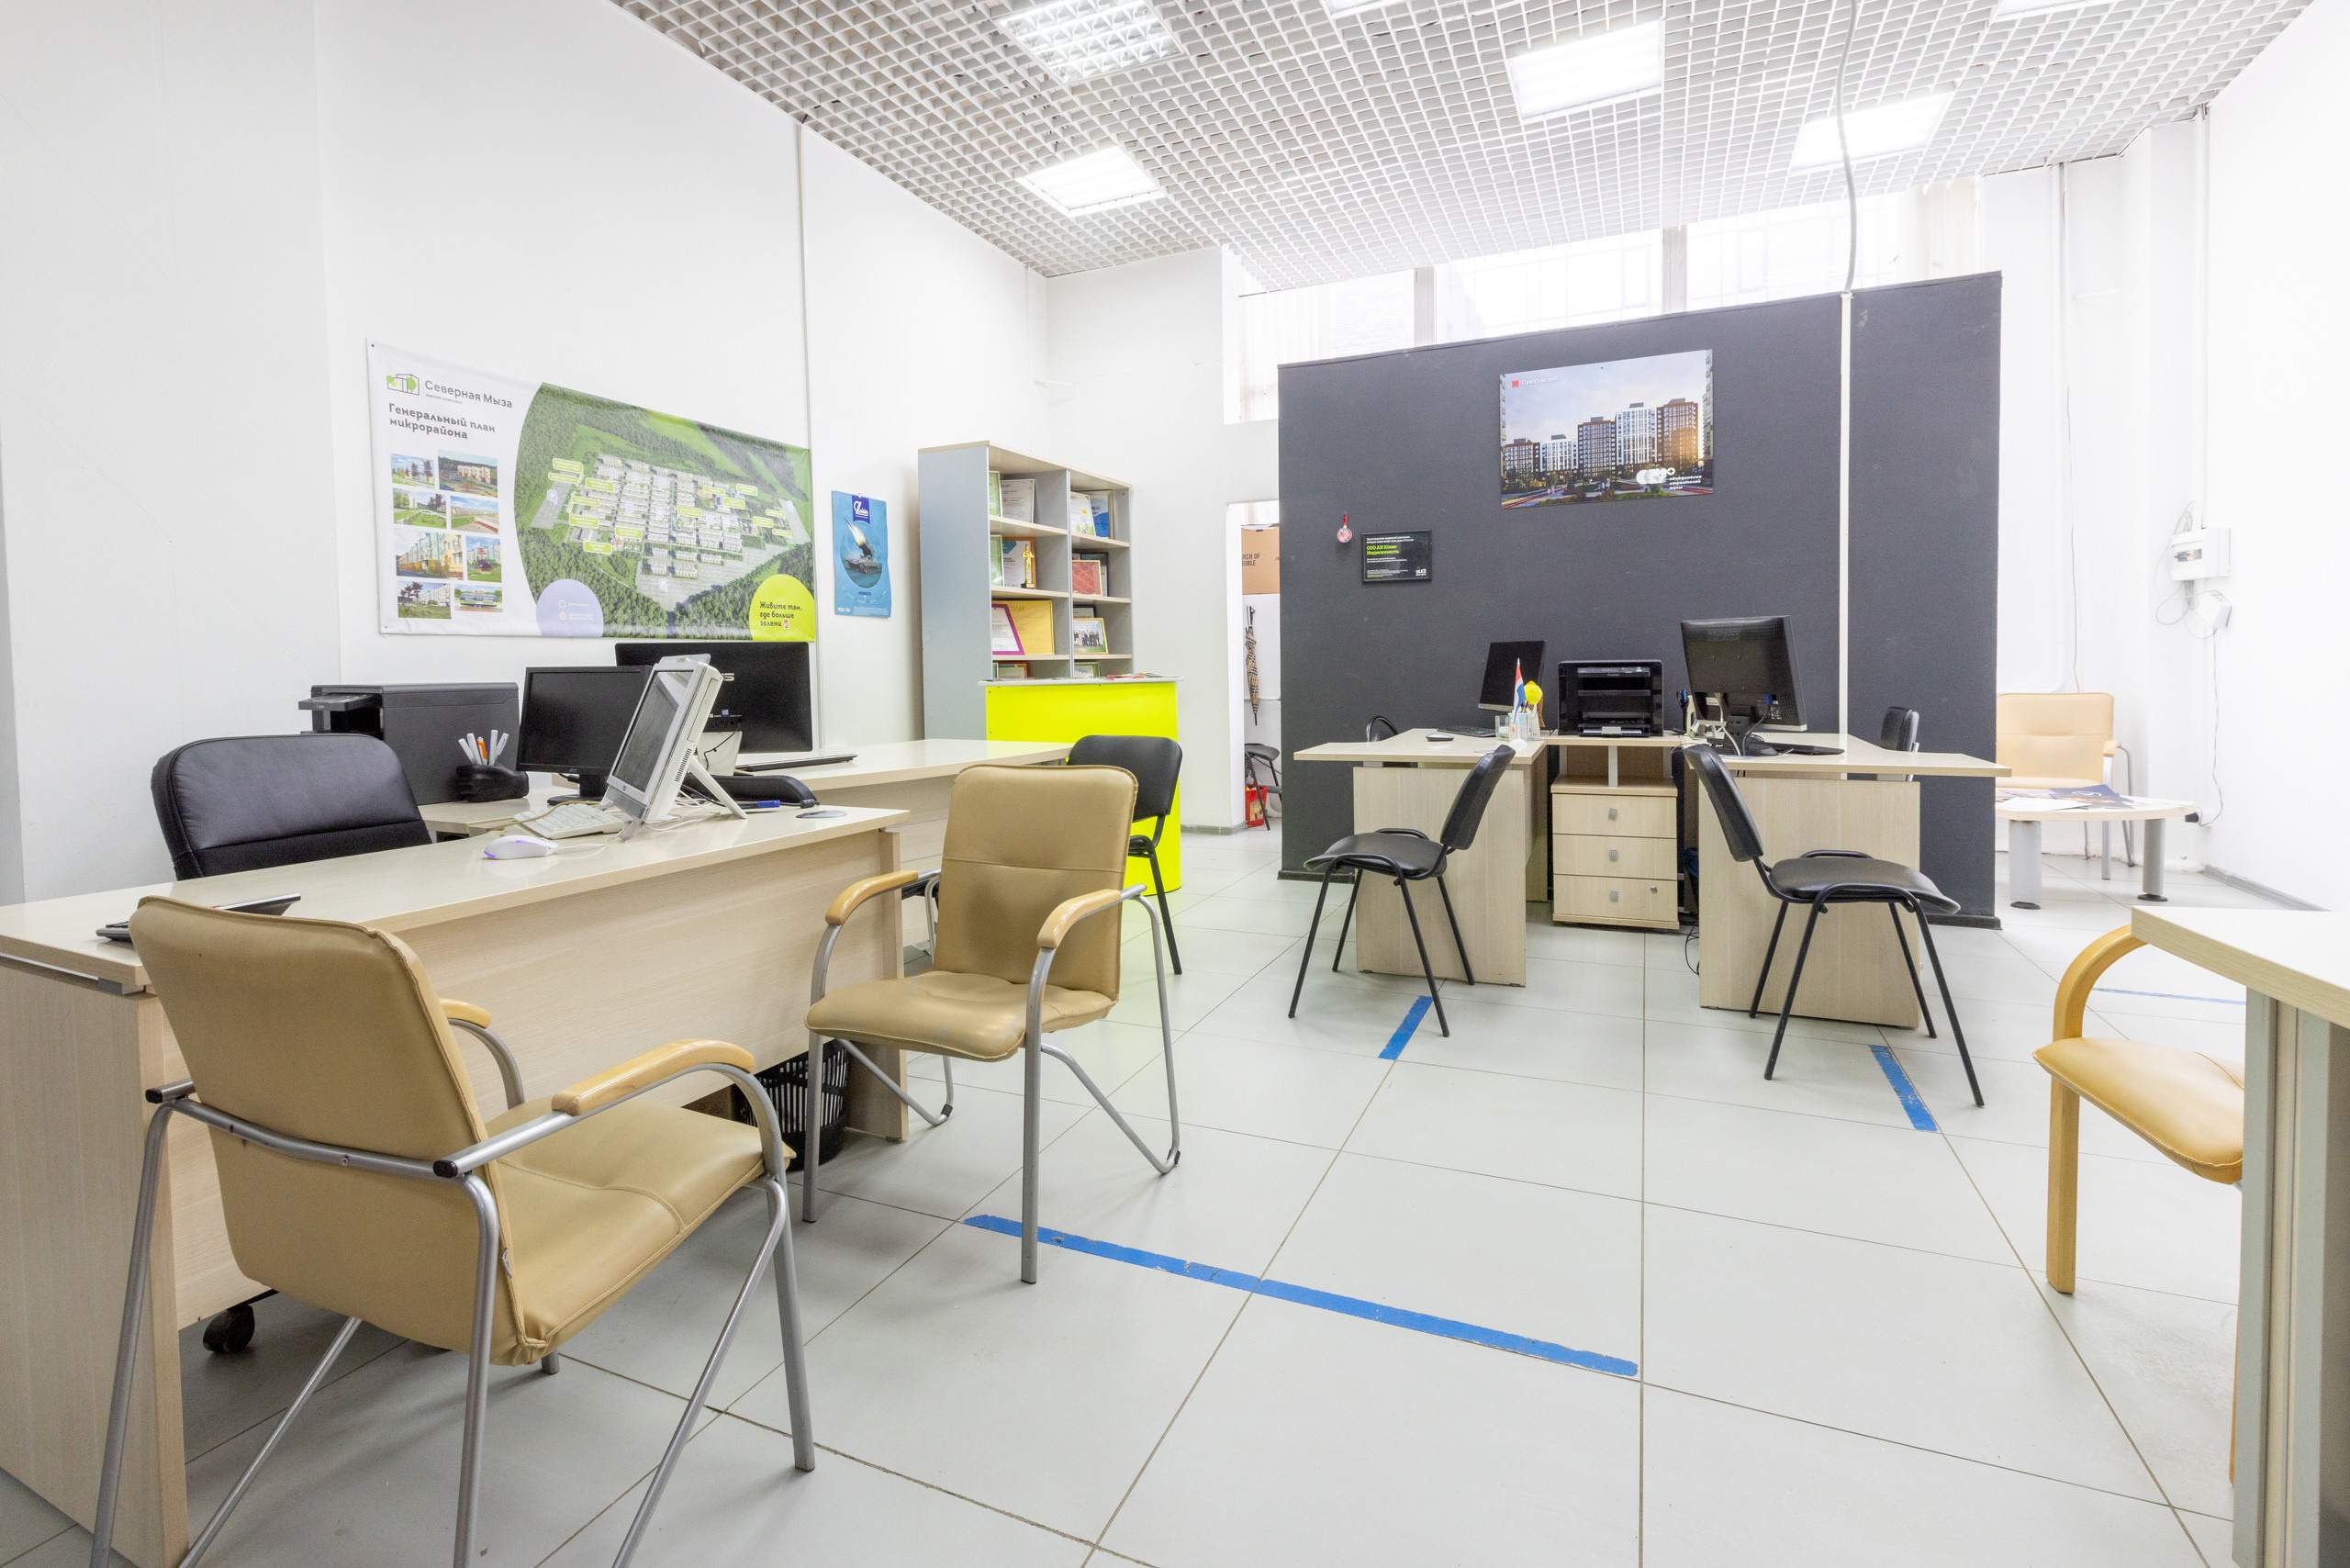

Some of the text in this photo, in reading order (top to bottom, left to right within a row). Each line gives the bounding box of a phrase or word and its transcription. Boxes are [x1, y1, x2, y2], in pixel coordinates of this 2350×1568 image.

[425, 380, 512, 408] Северная Мыза
[388, 402, 496, 432] Генеральный план
[390, 418, 468, 439] микрорайона
[759, 601, 787, 610] Живите
[759, 610, 795, 620] где больше
